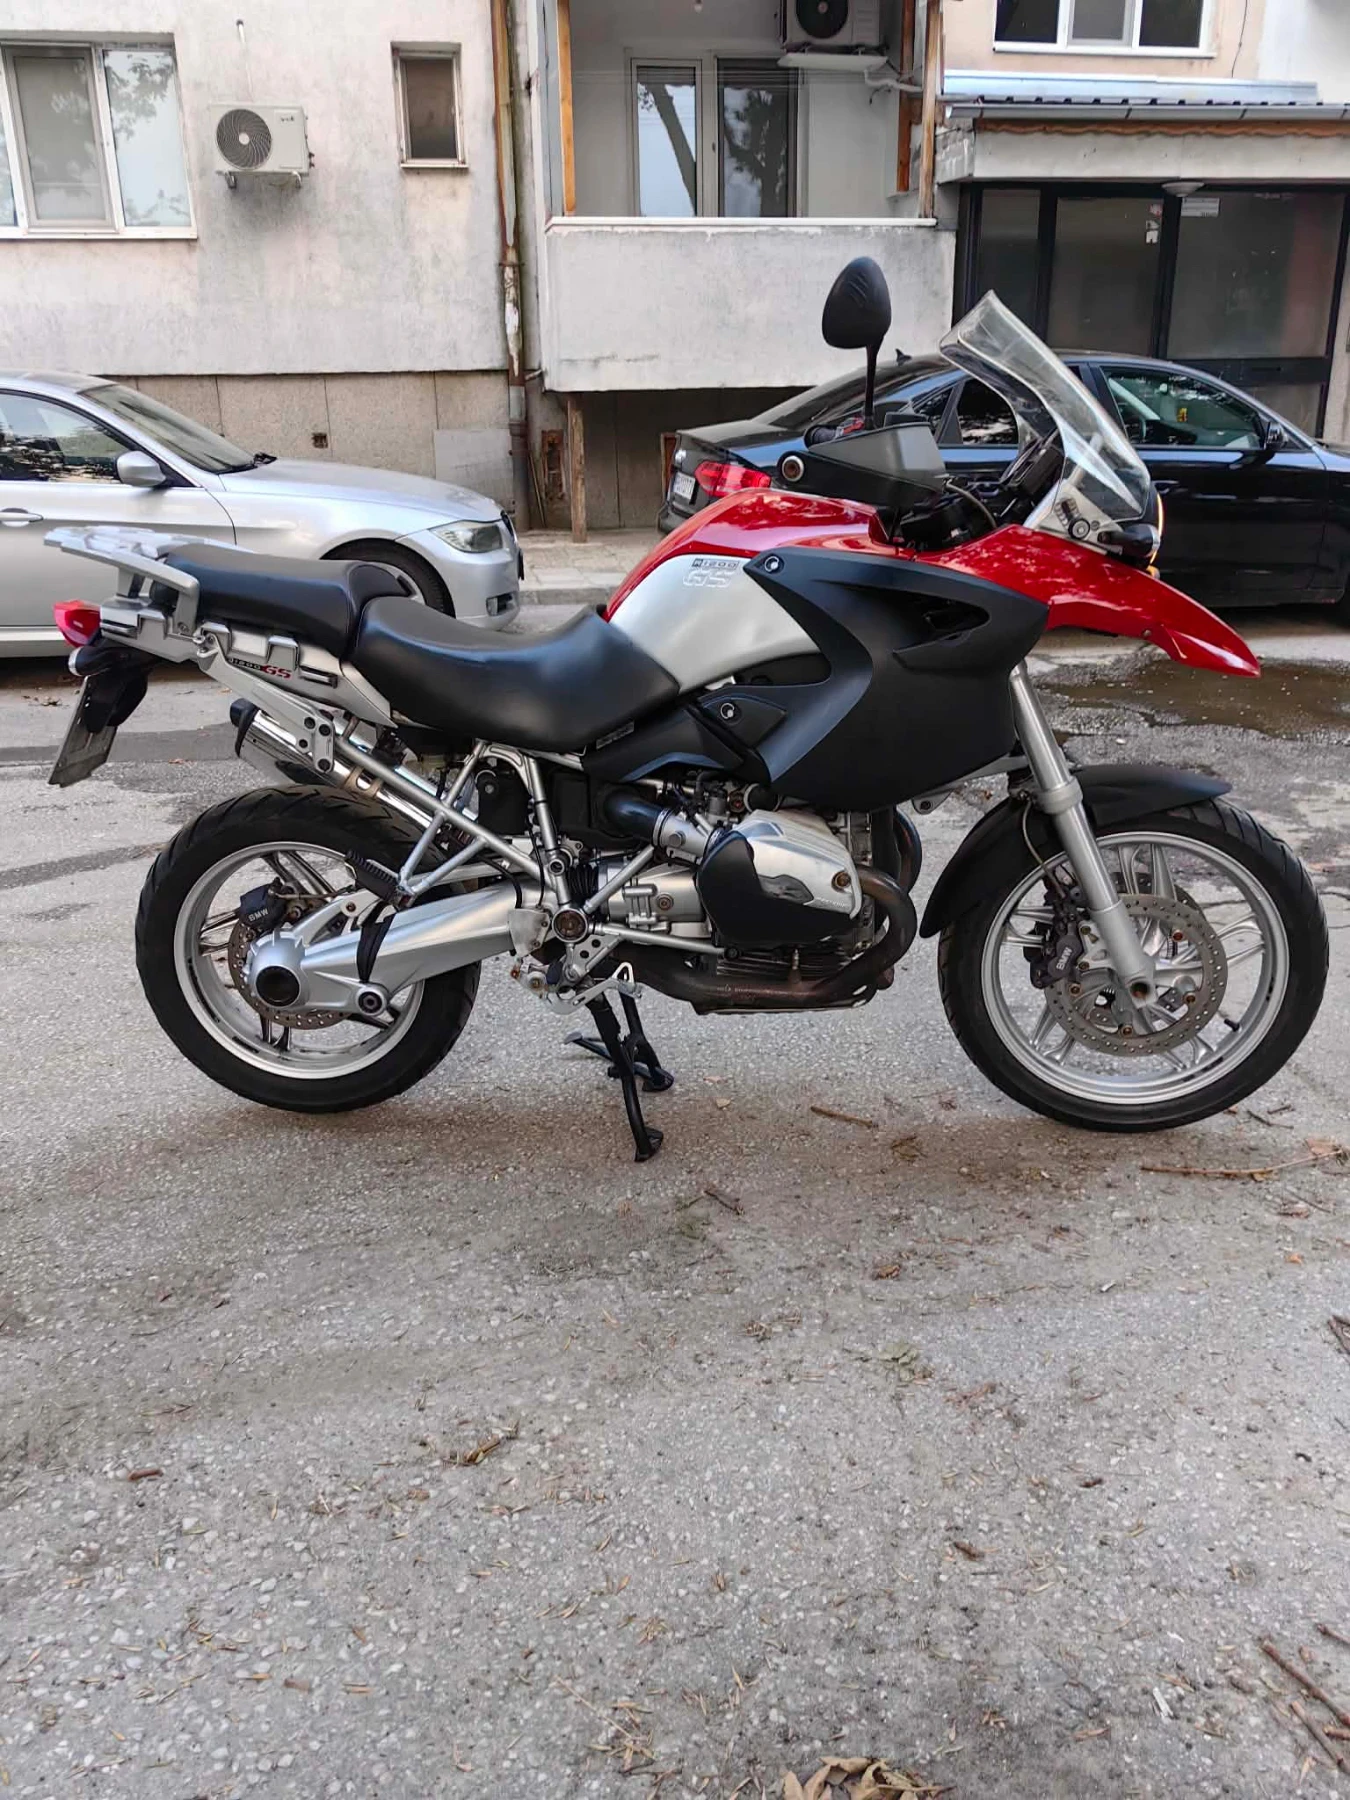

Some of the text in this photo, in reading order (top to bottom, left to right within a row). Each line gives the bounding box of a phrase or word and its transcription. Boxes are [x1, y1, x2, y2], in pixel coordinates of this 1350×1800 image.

[683, 569, 735, 588] GS
[262, 664, 292, 678] GS
[248, 908, 269, 922] BMW
[1056, 946, 1072, 971] BMW
